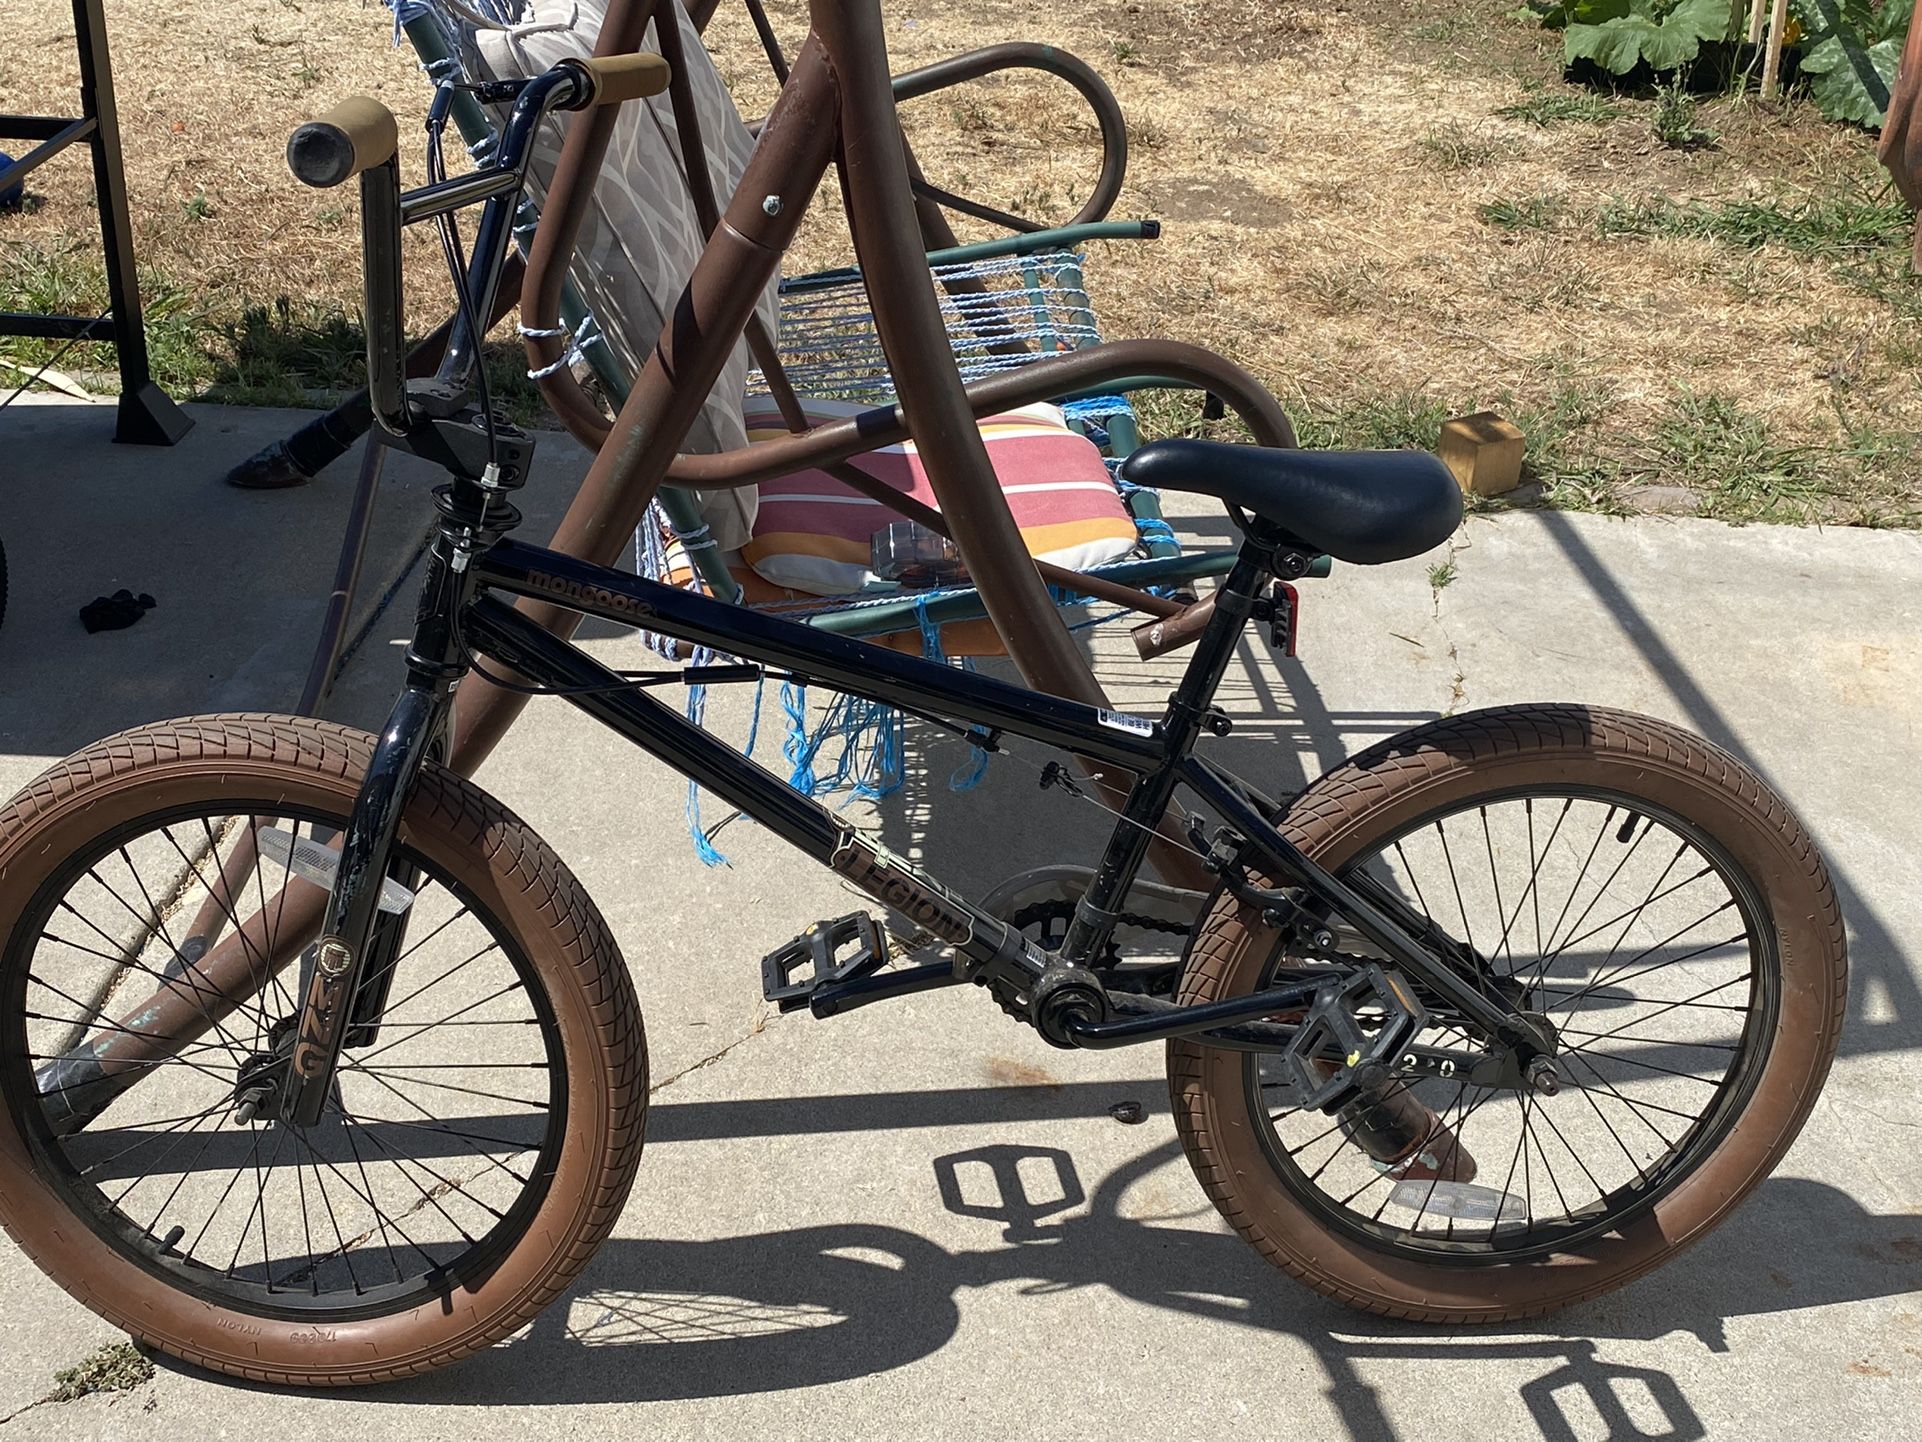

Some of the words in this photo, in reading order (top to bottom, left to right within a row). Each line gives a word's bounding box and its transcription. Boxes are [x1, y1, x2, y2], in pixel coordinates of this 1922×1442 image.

[526, 568, 655, 617] mongoose
[839, 850, 964, 939] LEGION
[217, 1318, 262, 1335] NYLON
